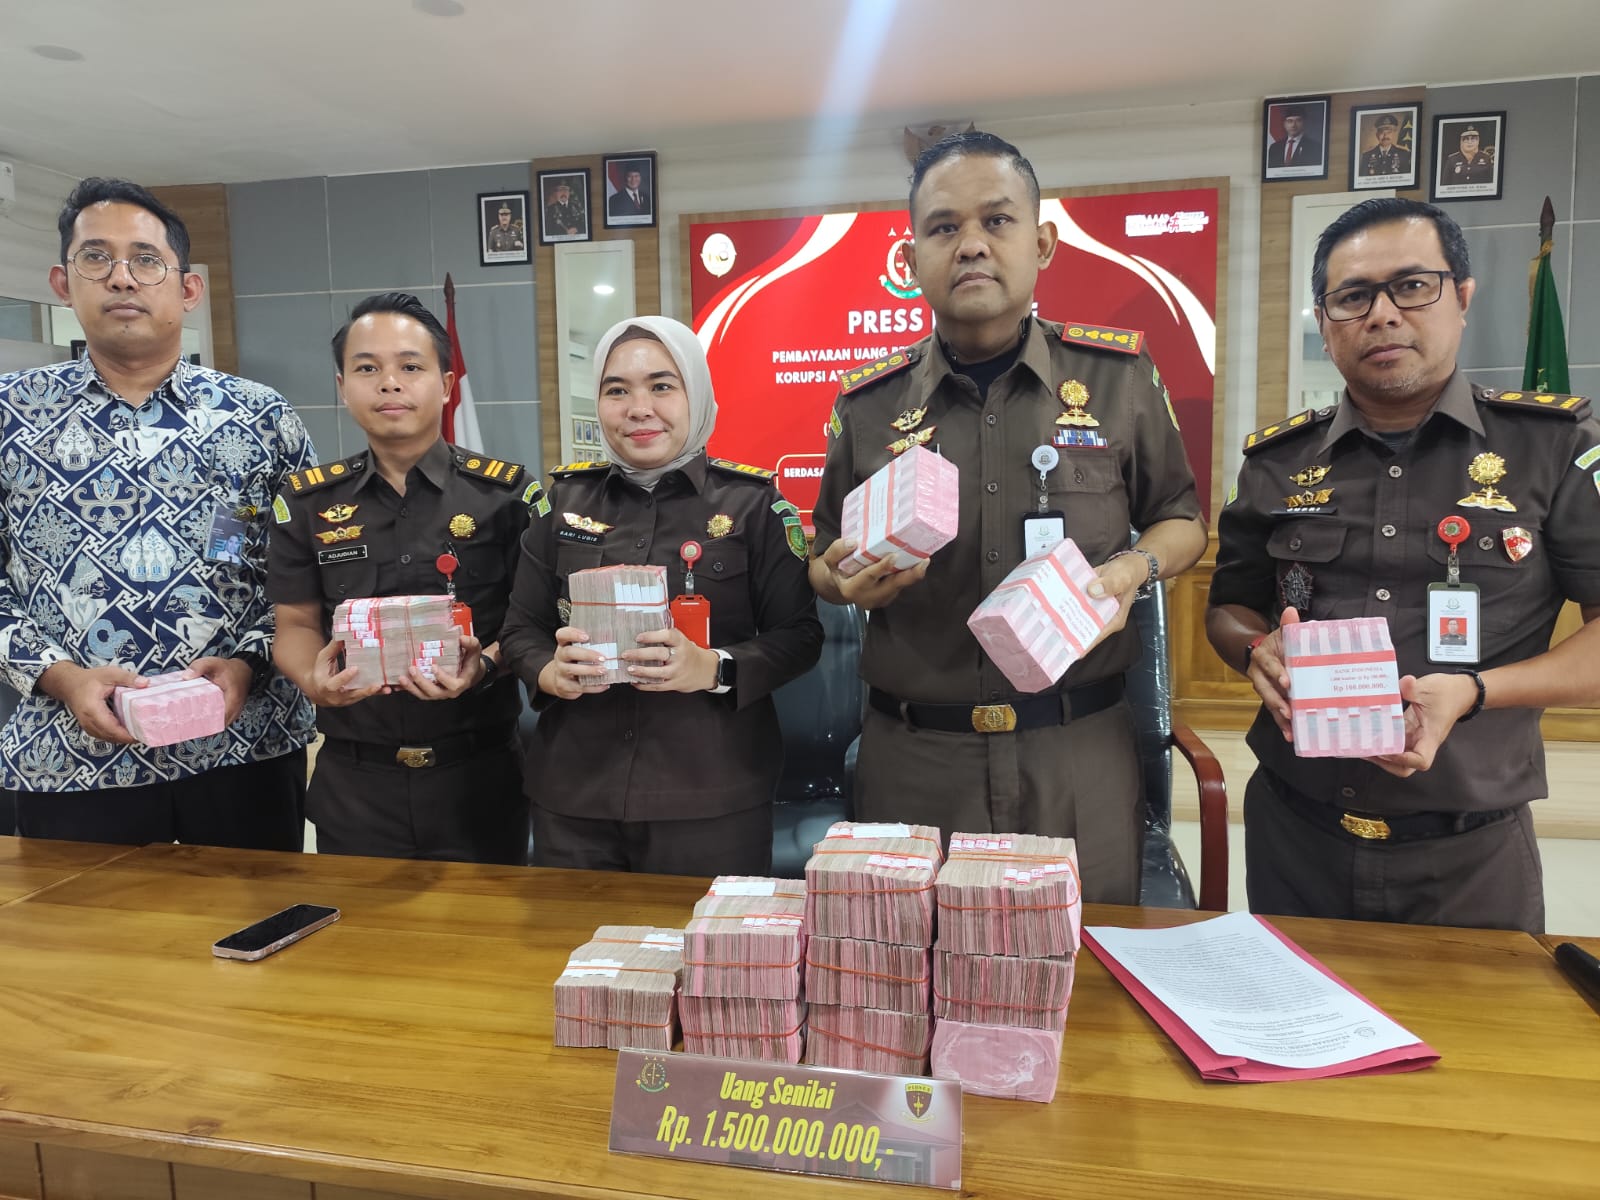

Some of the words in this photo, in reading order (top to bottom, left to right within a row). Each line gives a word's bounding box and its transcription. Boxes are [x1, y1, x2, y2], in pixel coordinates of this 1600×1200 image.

[848, 307, 924, 335] PRESS
[772, 348, 851, 363] PEMBAYARAN
[853, 346, 889, 360] UANG
[775, 370, 826, 384] KORUPSI
[720, 1071, 769, 1109] Uang
[769, 1076, 837, 1110] Senilai
[656, 1105, 692, 1152] Rp.
[701, 1110, 895, 1171] 1.500.000.000,-
